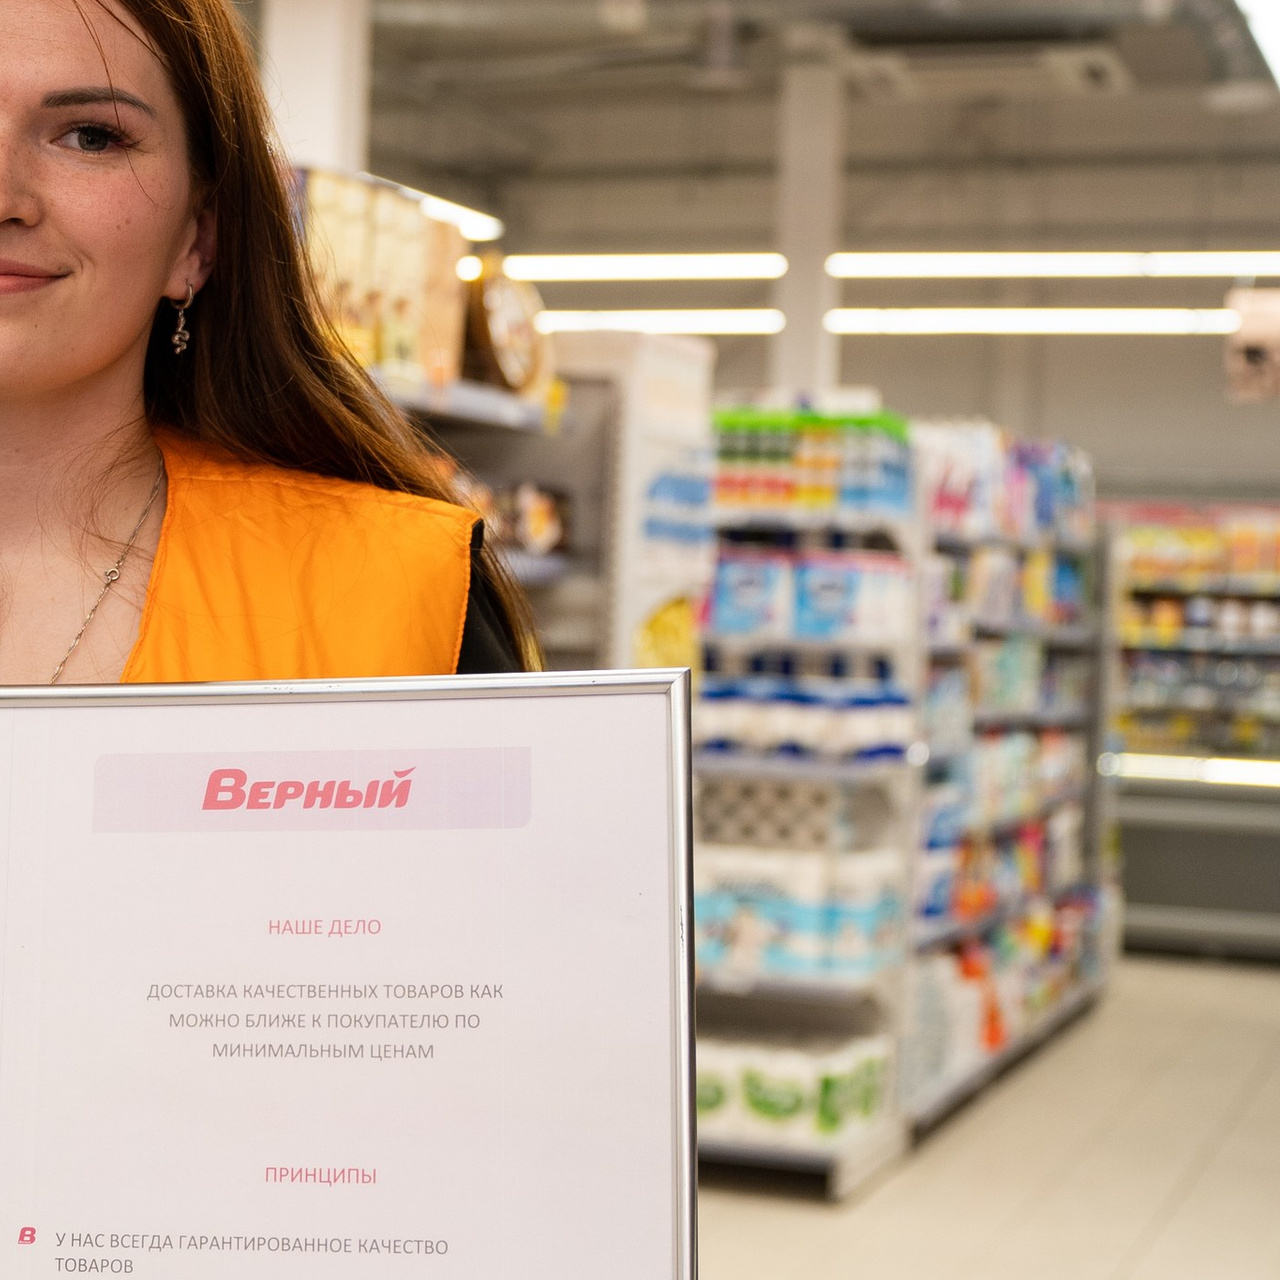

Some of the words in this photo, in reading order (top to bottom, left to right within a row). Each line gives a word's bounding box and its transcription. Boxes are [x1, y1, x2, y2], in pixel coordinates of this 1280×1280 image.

[268, 919, 324, 935] НАШЕ
[327, 919, 382, 939] ДЕЛО
[146, 983, 238, 1002] ДОСТАВКА
[243, 984, 379, 999] КАЧЕСТВЕННЫХ
[382, 984, 465, 999] ТОВАРОВ
[470, 984, 504, 999] КАК
[169, 1013, 240, 1028] МОЖНО
[245, 1013, 307, 1029] БЛИЖЕ
[311, 1013, 322, 1029] К
[327, 1013, 450, 1029] ПОКУПАТЕЛЮ
[454, 1013, 481, 1029] ПО
[212, 1043, 364, 1059] МИНИМАЛЬНЫМ
[370, 1044, 434, 1062] ЦЕНАМ
[265, 1166, 377, 1188] ПРИНЦИПЫ
[55, 1232, 67, 1247] У
[71, 1232, 105, 1248] НАС
[109, 1233, 174, 1253] ВСЕГДА
[178, 1235, 353, 1253] ГАРАНТИРОВАННОЕ
[358, 1238, 449, 1255] КАЧЕСТВО
[54, 1257, 134, 1274] ТОВАРОВ
